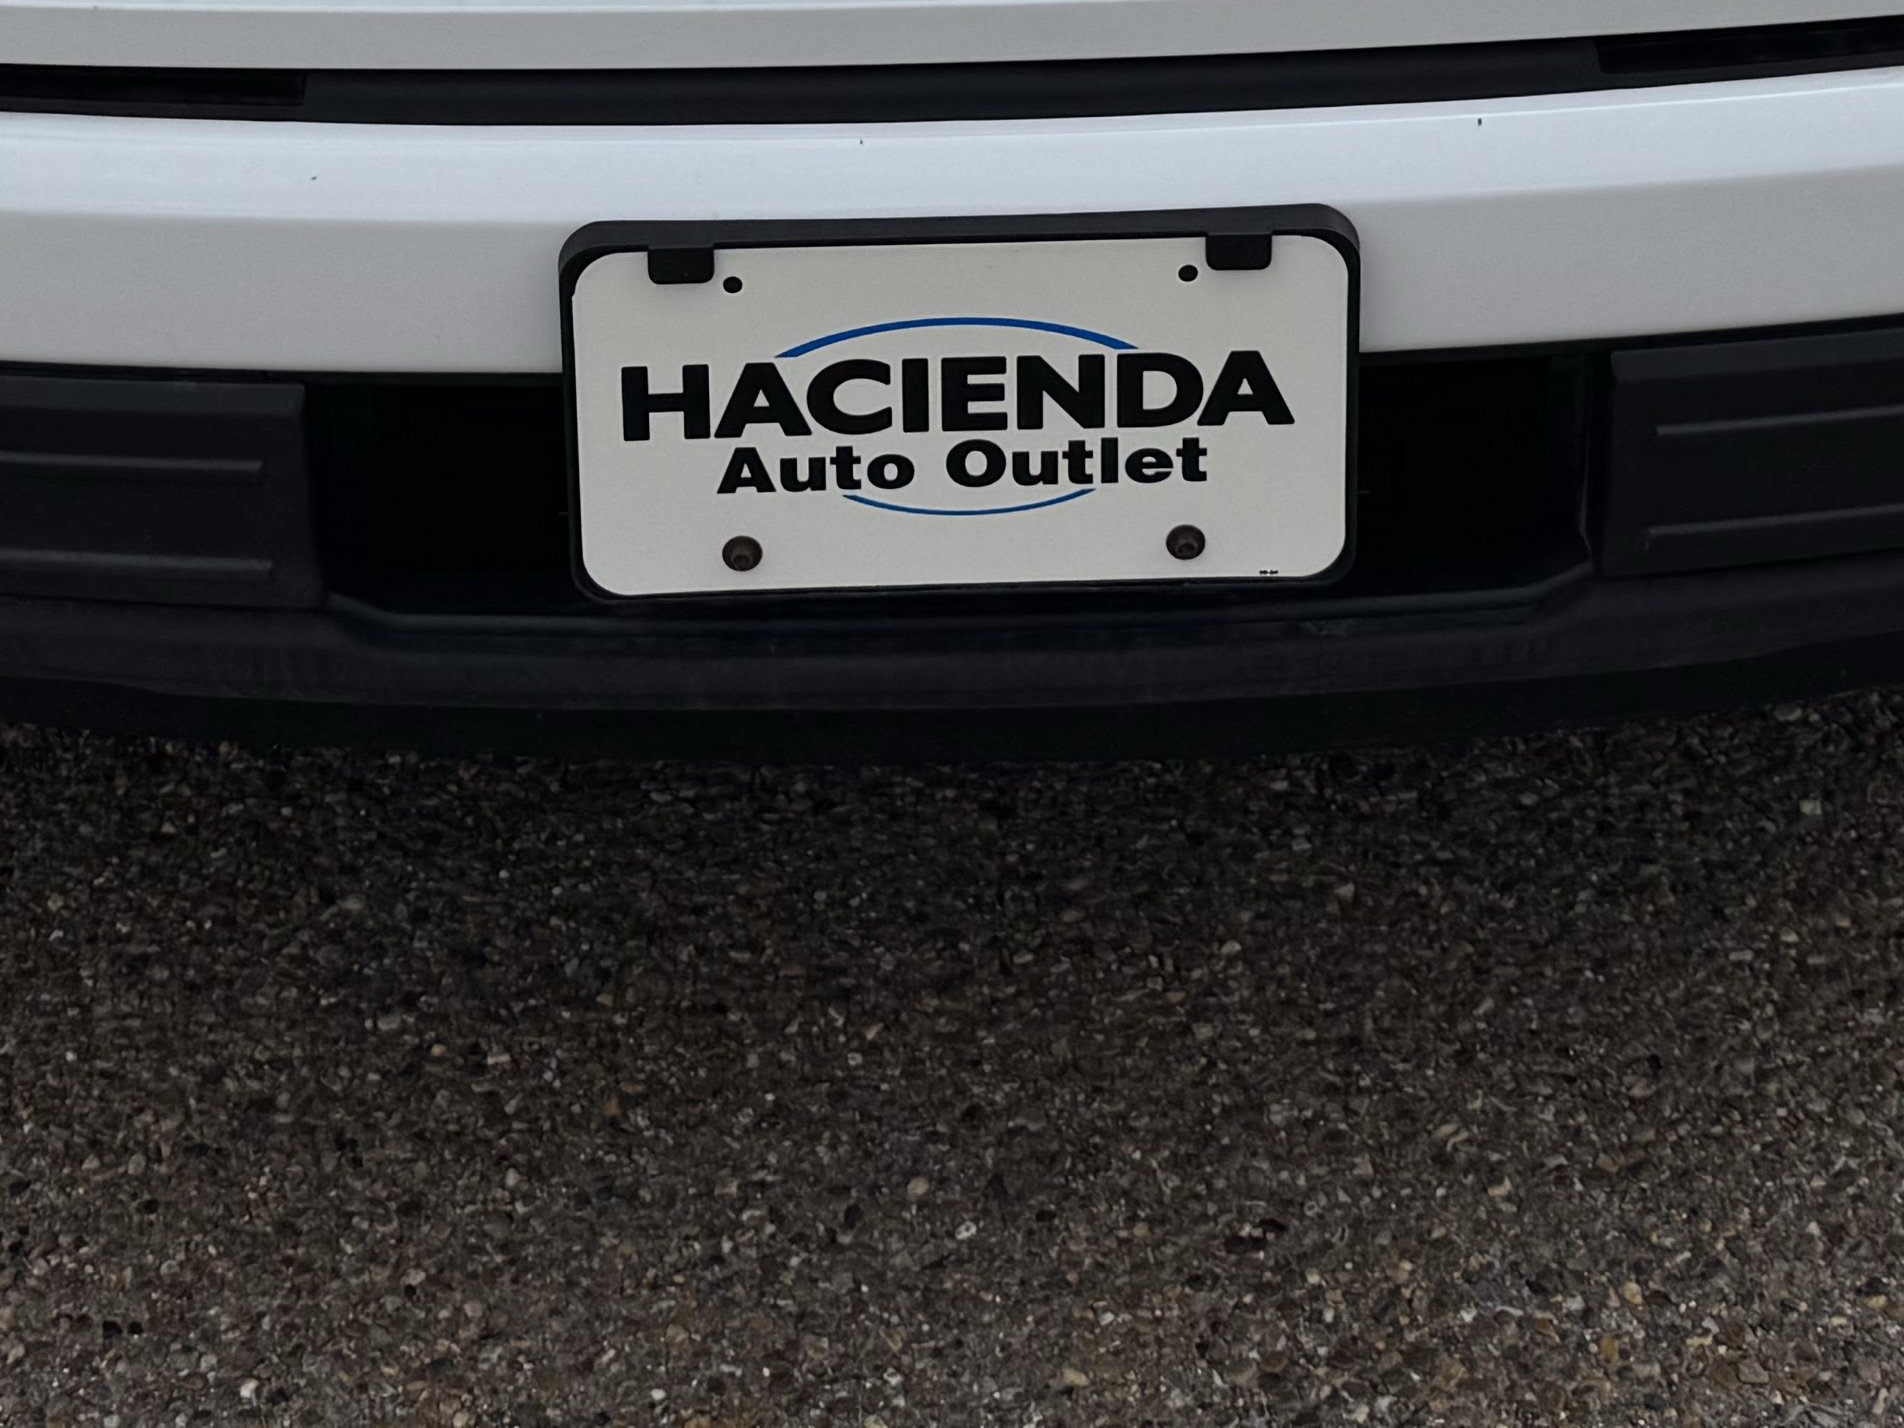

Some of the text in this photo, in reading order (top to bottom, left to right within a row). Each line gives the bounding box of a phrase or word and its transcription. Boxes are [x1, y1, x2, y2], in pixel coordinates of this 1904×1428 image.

[620, 349, 1297, 442] HACIENDA
[716, 436, 1209, 495] Auto Outlet
